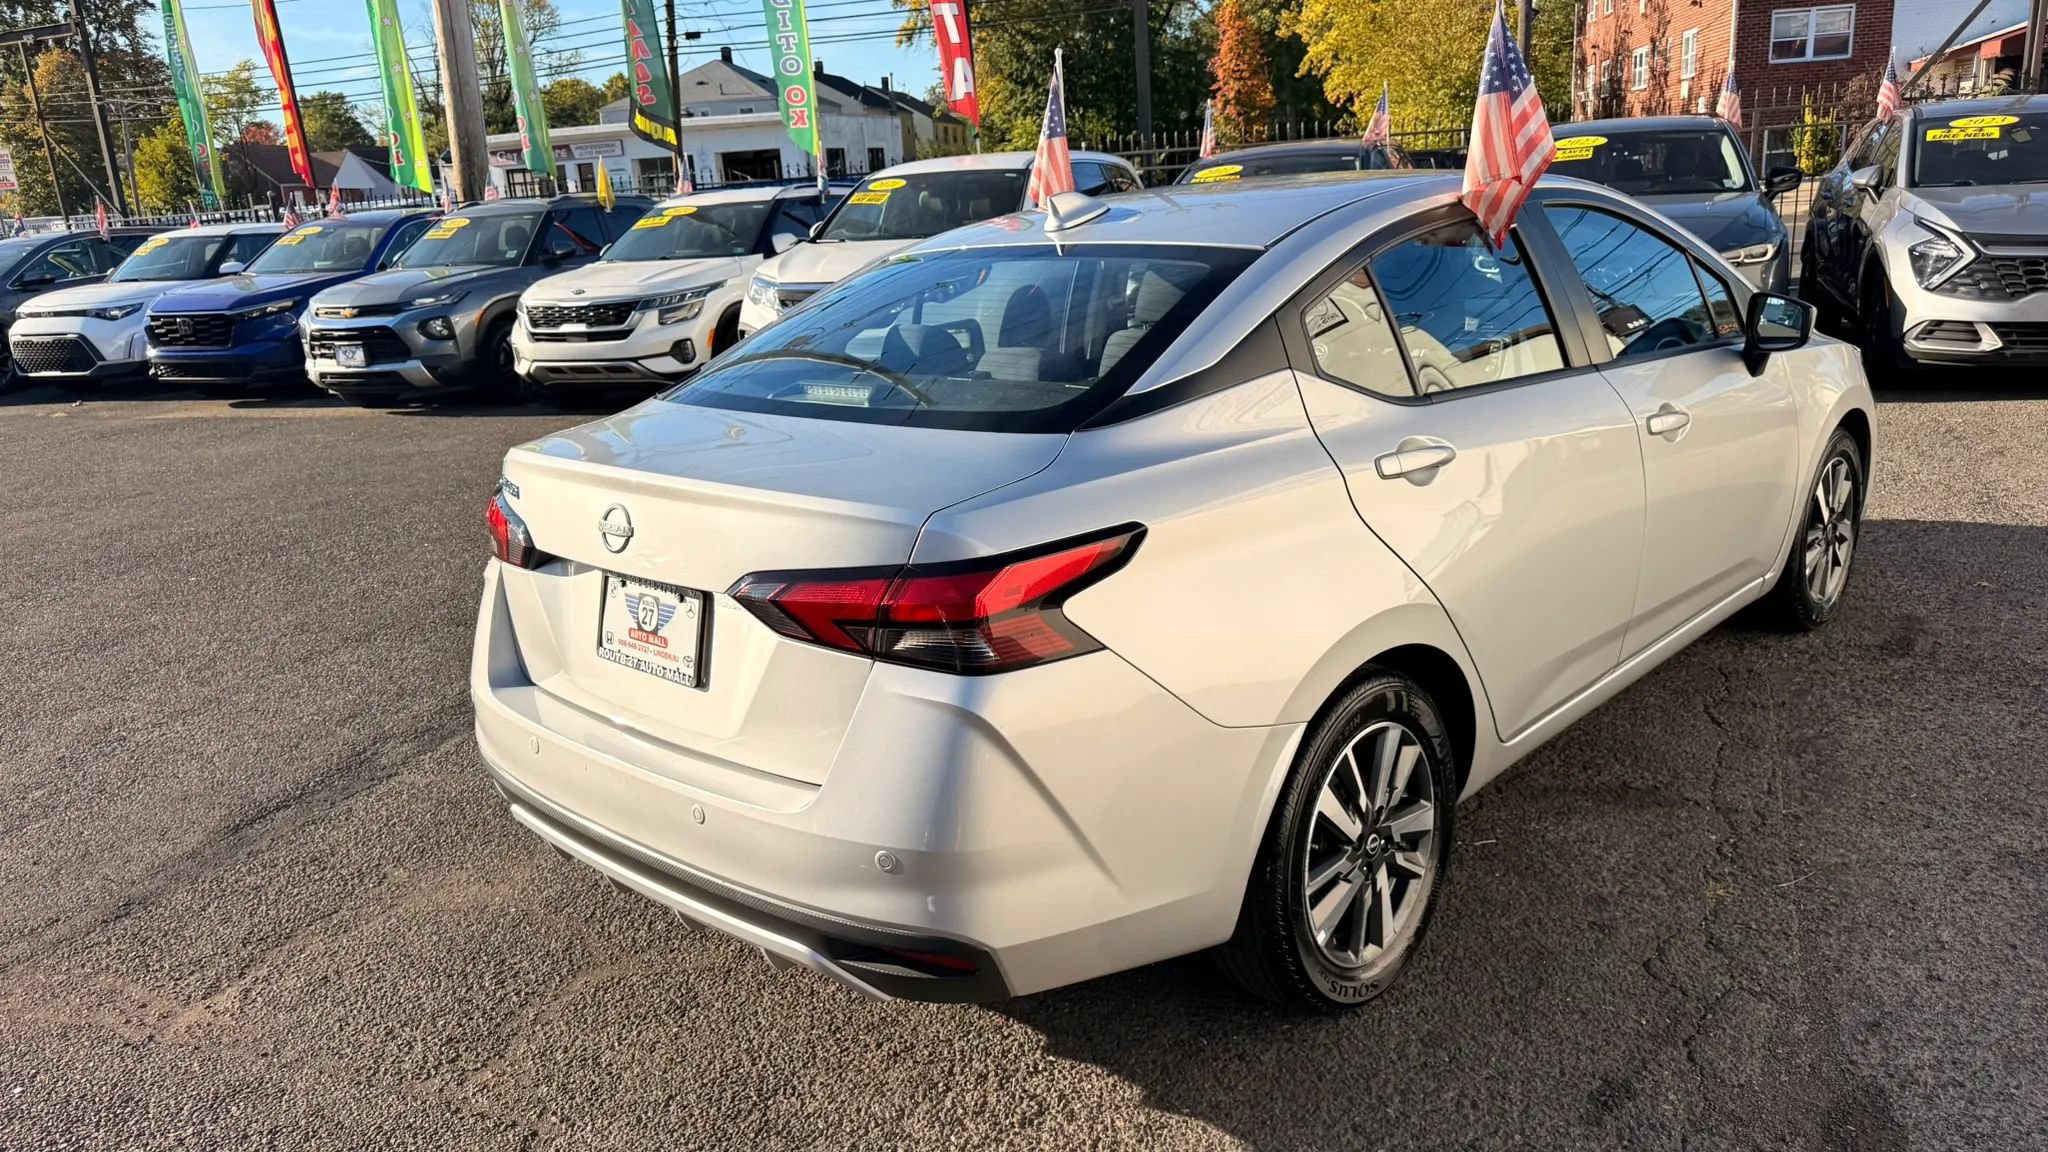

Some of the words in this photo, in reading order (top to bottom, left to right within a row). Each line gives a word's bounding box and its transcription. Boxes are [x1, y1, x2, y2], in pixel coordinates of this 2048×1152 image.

[1964, 116, 2008, 126] 2023
[641, 607, 655, 627] 27
[630, 630, 647, 641] AUTO
[628, 656, 639, 668] 27
[640, 660, 664, 677] AUTO
[665, 668, 692, 686] MALL
[1328, 980, 1379, 998] SOLUS
